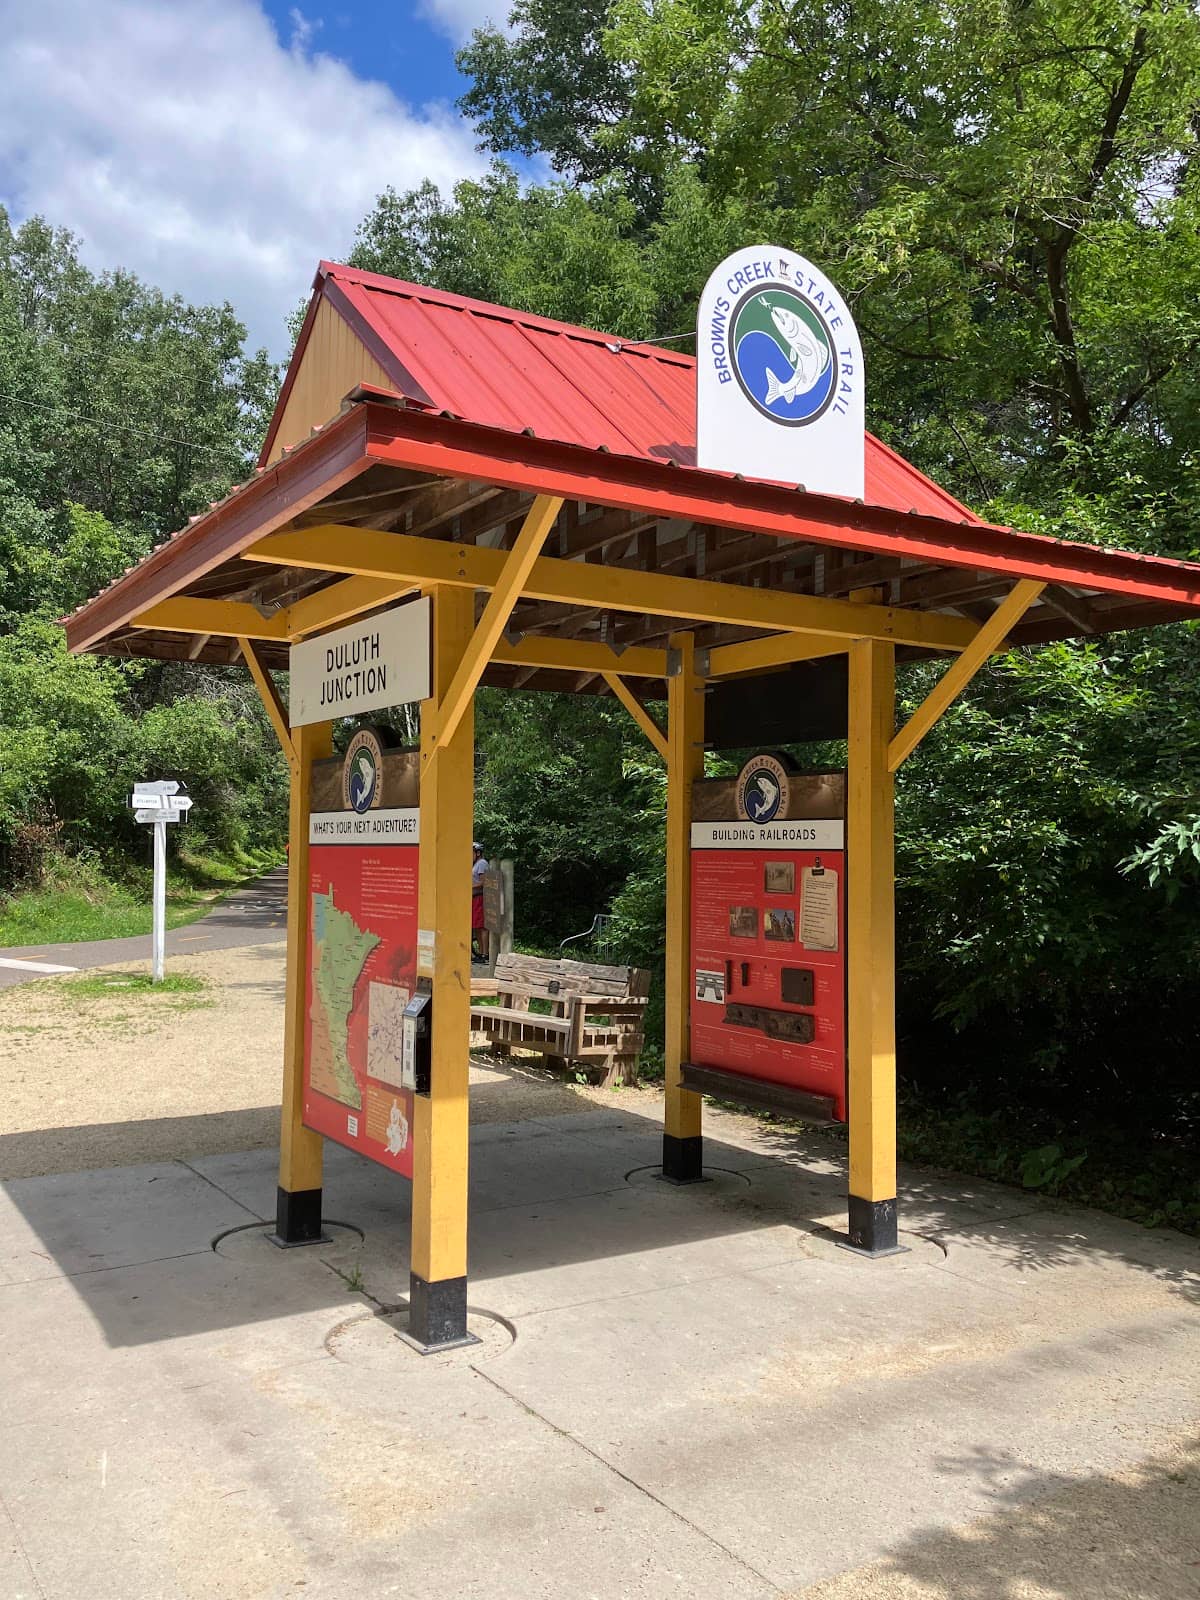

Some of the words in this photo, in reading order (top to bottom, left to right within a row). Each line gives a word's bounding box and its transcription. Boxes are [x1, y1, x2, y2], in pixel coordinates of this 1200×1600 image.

[711, 296, 732, 384] BROWN'S
[727, 261, 775, 295] CREEK
[794, 271, 843, 331] STATE
[832, 347, 854, 415] TRAIL
[326, 632, 380, 673] DULUTH
[320, 664, 386, 705] JUNCTION
[313, 822, 334, 834] WHAT'S
[336, 821, 352, 834] YOUR
[354, 820, 370, 833] NEXT
[373, 819, 416, 833] ADVENTURE?
[712, 829, 755, 841] BUILDING
[760, 828, 816, 841] RAILROADS
